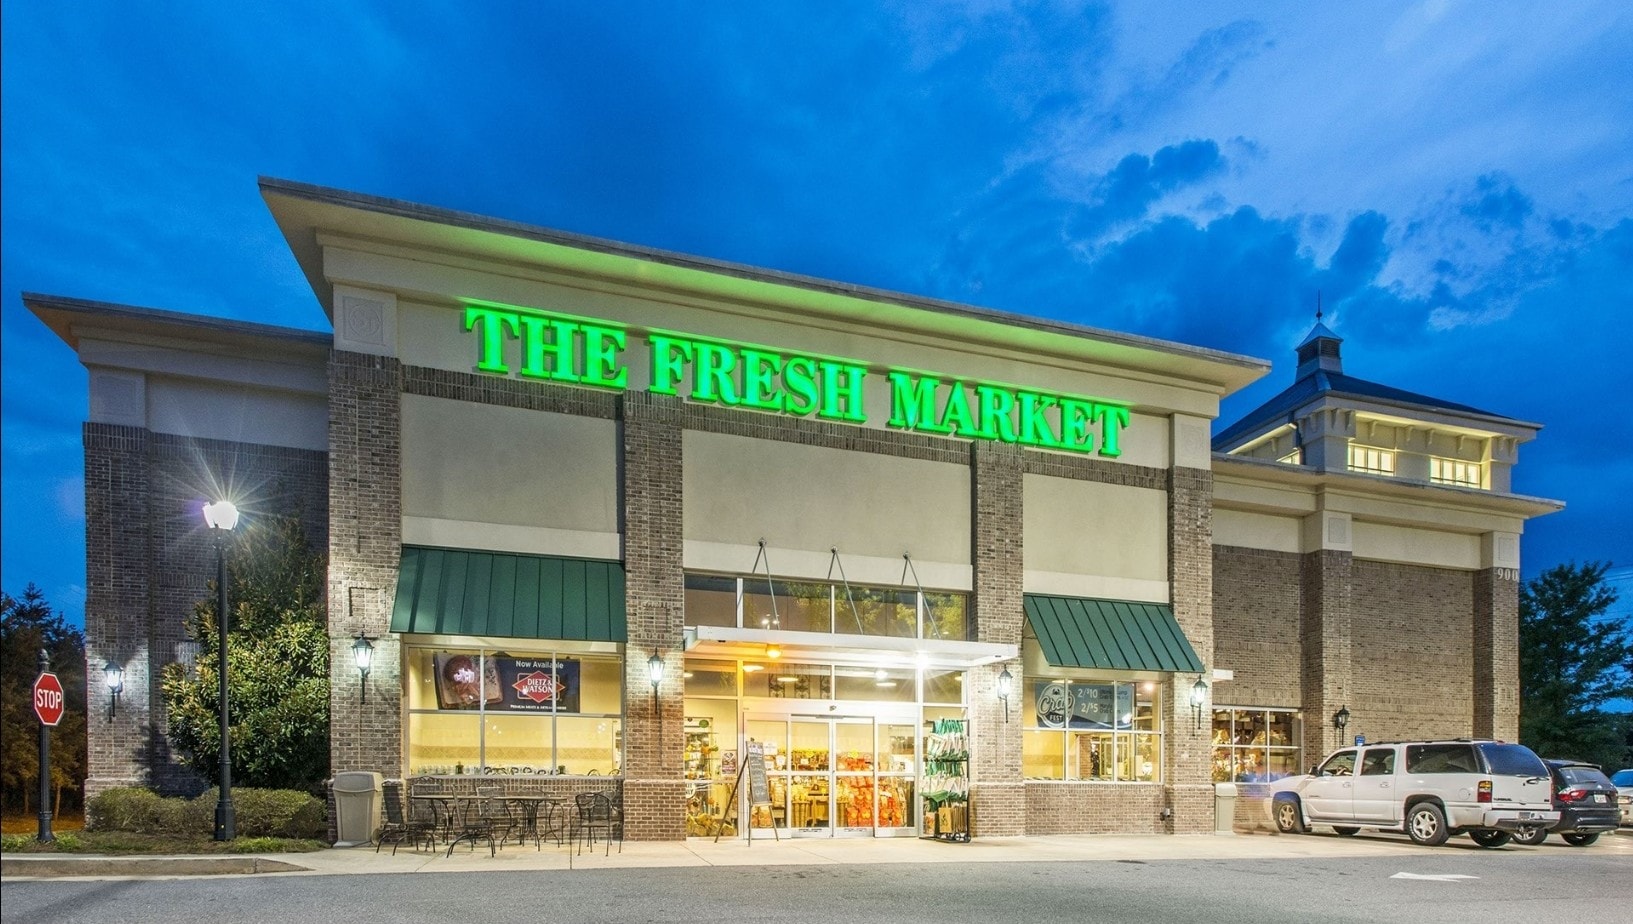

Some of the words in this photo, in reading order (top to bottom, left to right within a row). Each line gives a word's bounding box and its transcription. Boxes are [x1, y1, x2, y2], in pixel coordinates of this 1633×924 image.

[465, 307, 628, 389] THE
[648, 334, 869, 423] FRESH
[887, 371, 1130, 458] MARKET
[1497, 568, 1518, 581] 900
[516, 660, 531, 668] Now
[37, 689, 61, 709] STOP
